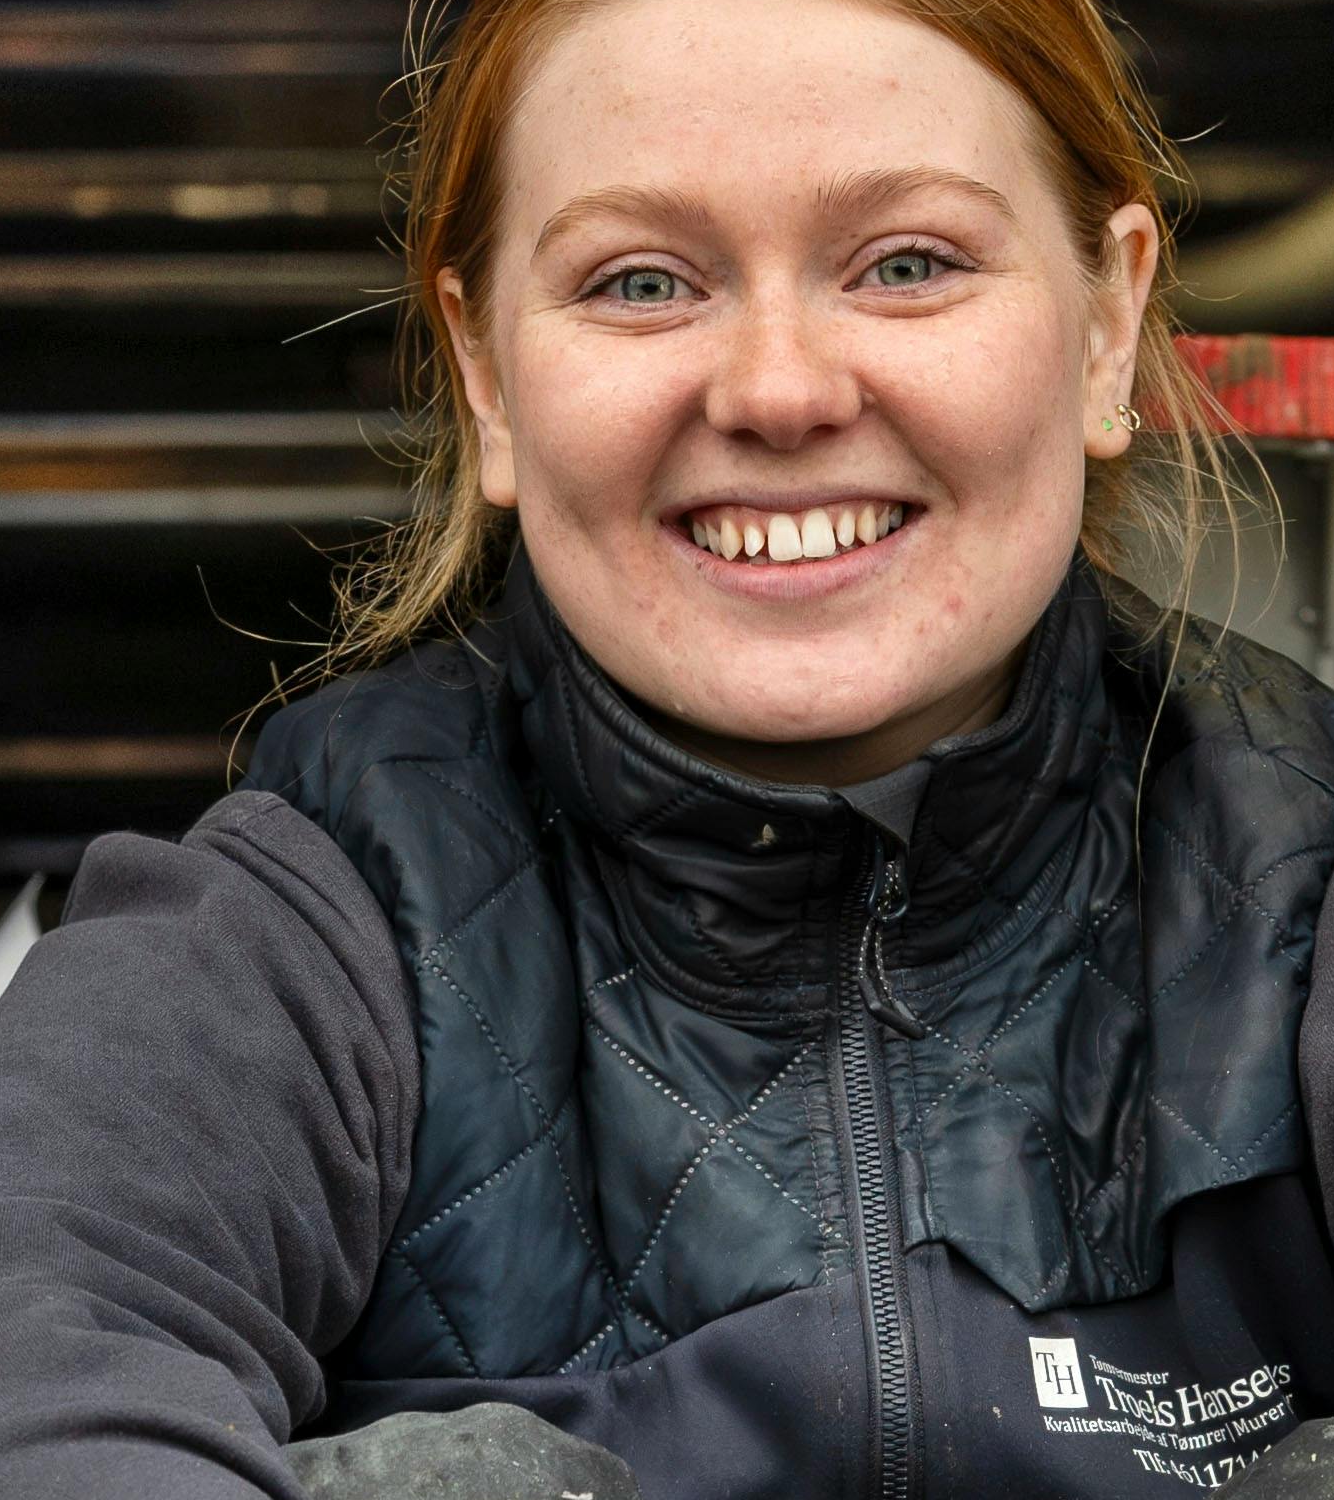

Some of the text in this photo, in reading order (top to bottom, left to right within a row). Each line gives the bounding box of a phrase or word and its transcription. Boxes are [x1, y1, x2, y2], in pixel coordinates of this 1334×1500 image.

[1094, 1375, 1177, 1428] Troels
[1043, 1415, 1156, 1442] Kvalitetsarbejde
[1168, 1427, 1227, 1451] Tømrer
[1231, 1402, 1285, 1437] Murer
[1132, 1448, 1171, 1475] Tlf:
